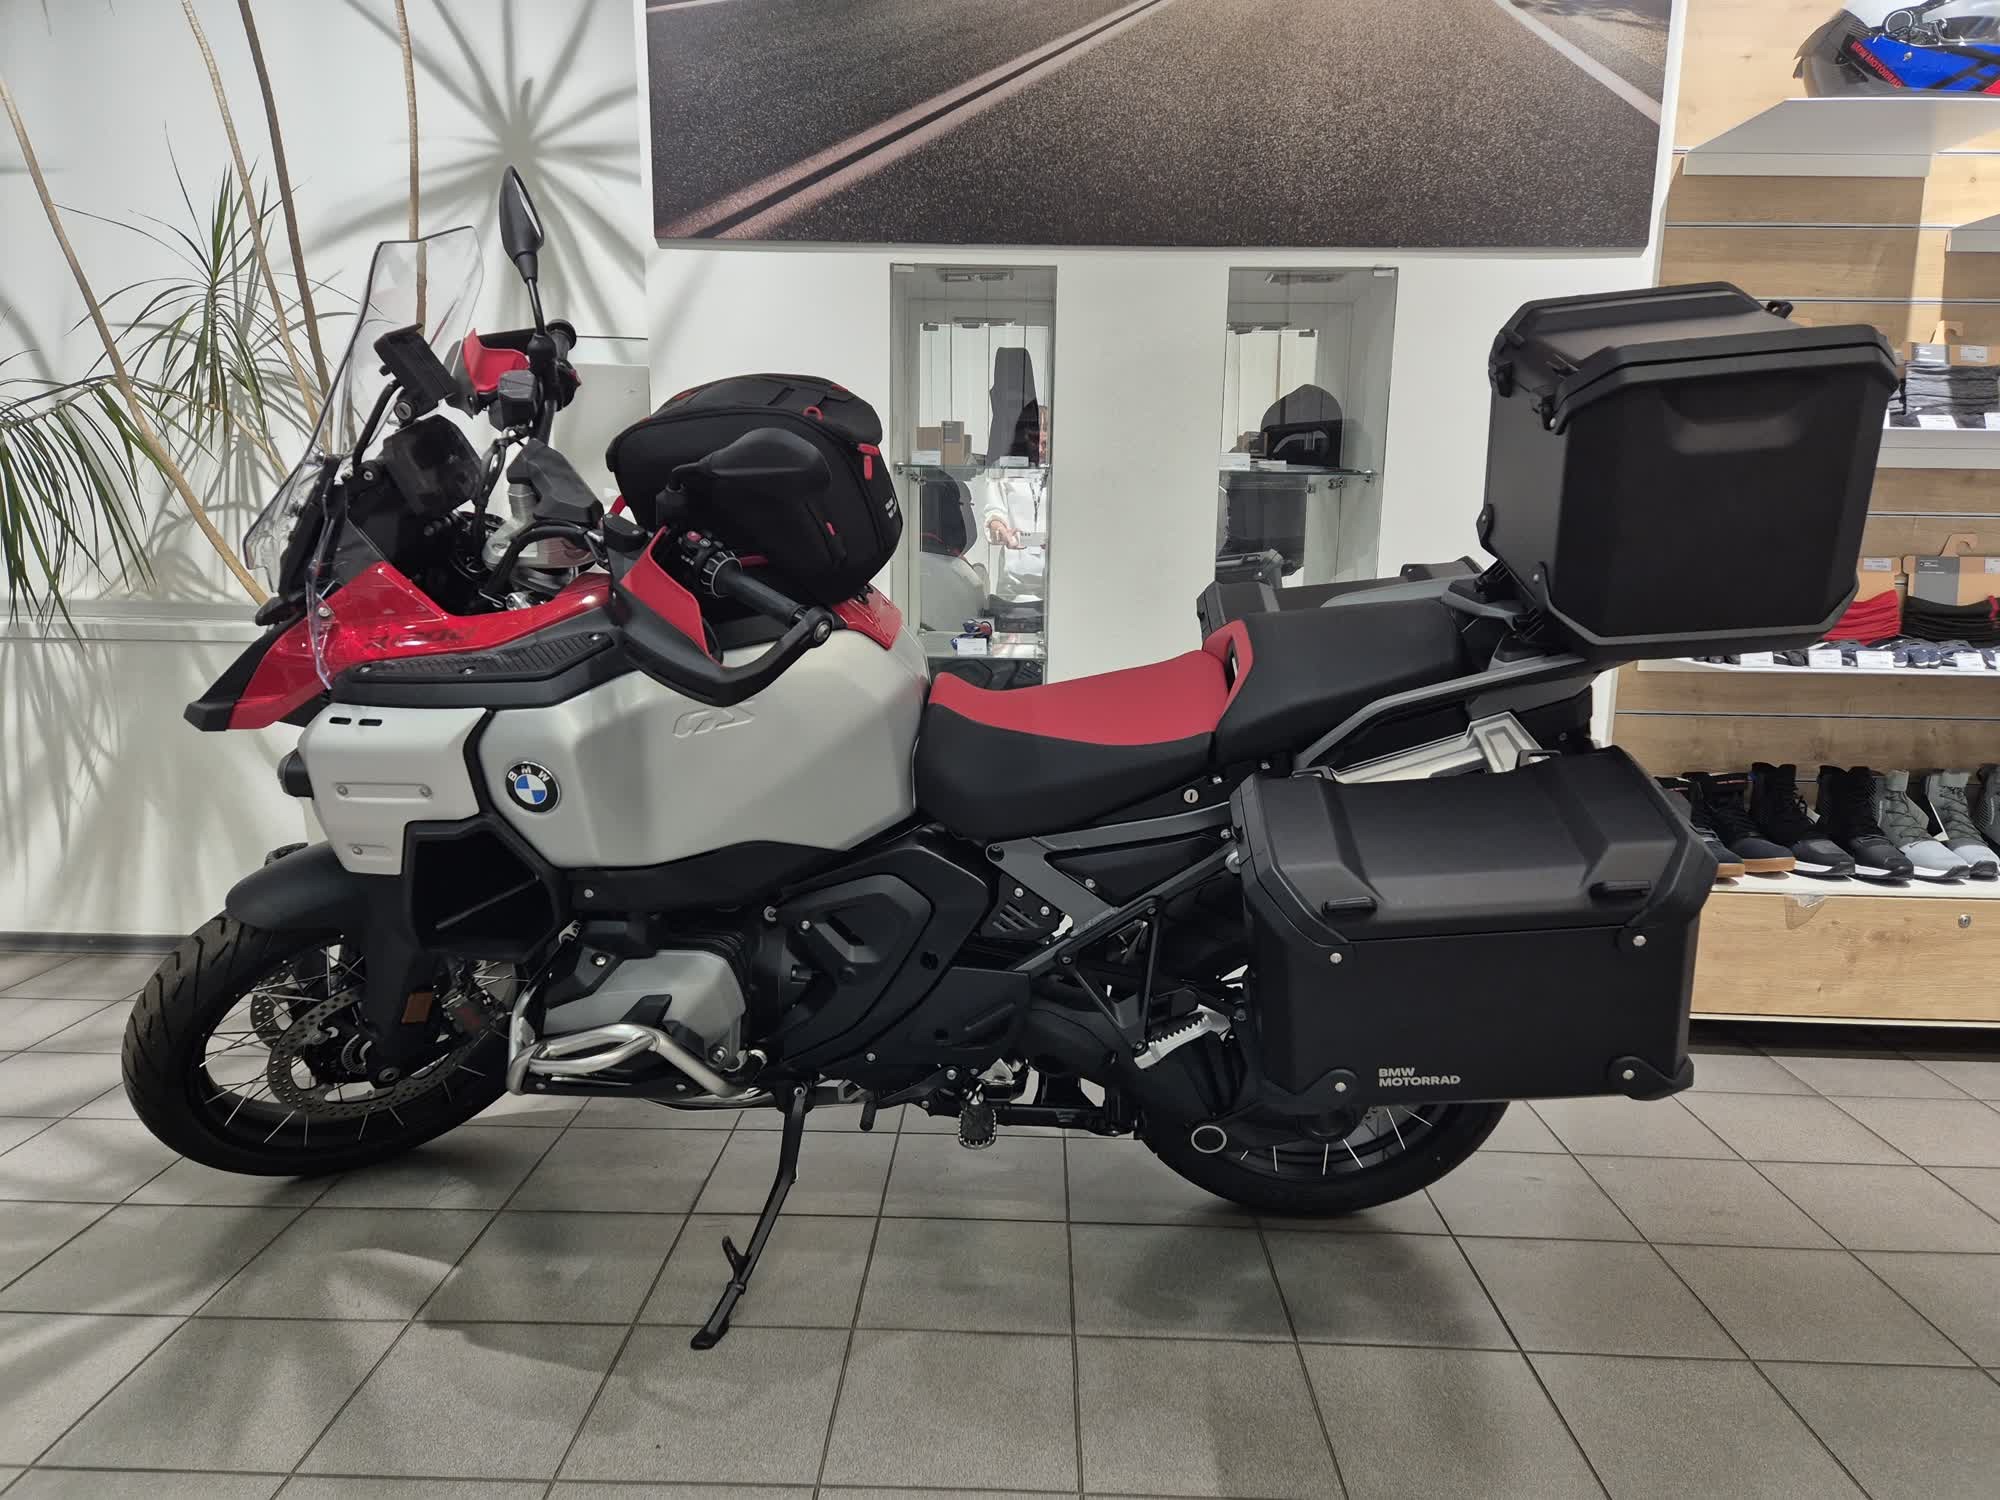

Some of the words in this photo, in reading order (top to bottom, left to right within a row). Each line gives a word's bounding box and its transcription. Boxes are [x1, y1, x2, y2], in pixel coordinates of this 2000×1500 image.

[507, 765, 551, 782] BMW
[1378, 1067, 1416, 1078] BMW
[1378, 1074, 1461, 1088] MOTORRAD
